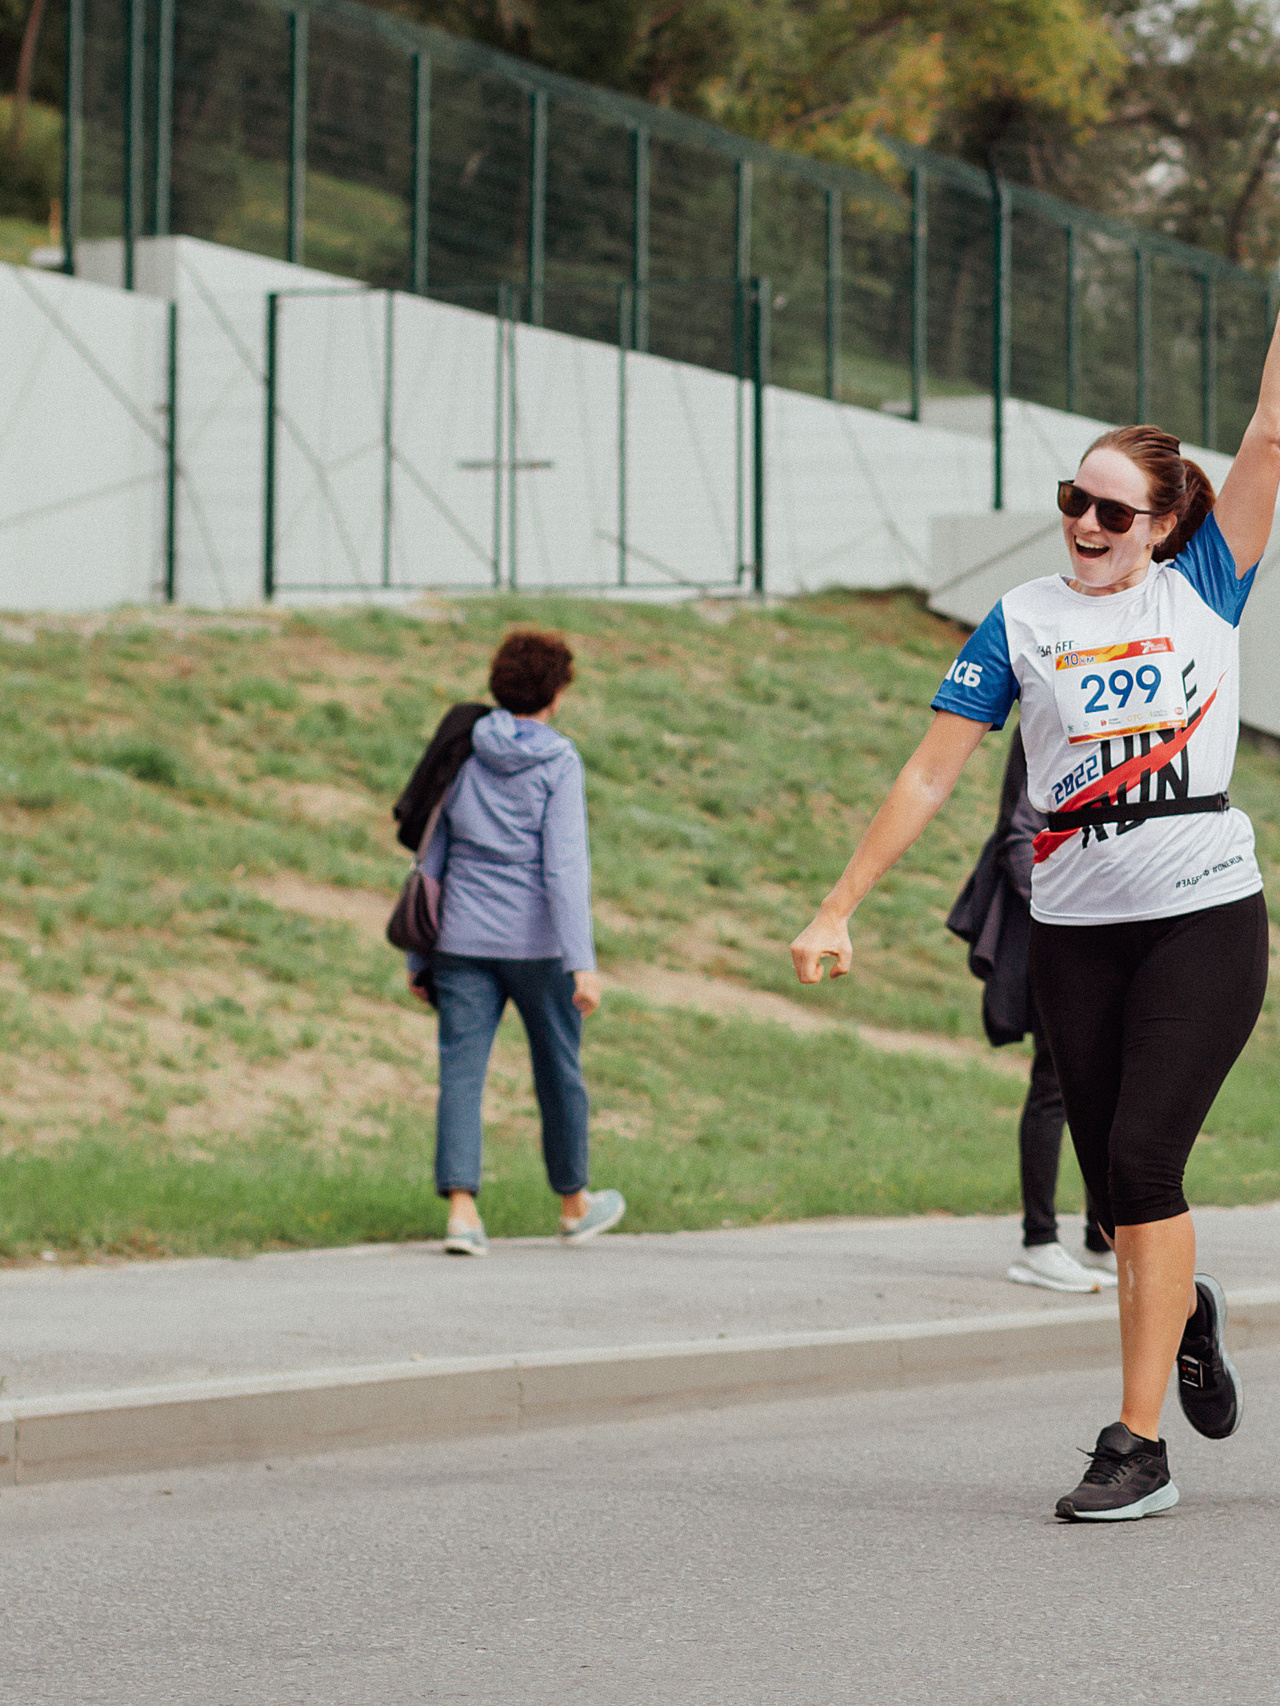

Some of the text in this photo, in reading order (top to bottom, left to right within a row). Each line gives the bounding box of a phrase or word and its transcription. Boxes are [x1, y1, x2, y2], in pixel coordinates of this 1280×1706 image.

[1063, 653, 1079, 667] 10
[1080, 664, 1162, 714] 299
[1051, 755, 1099, 805] 2022
